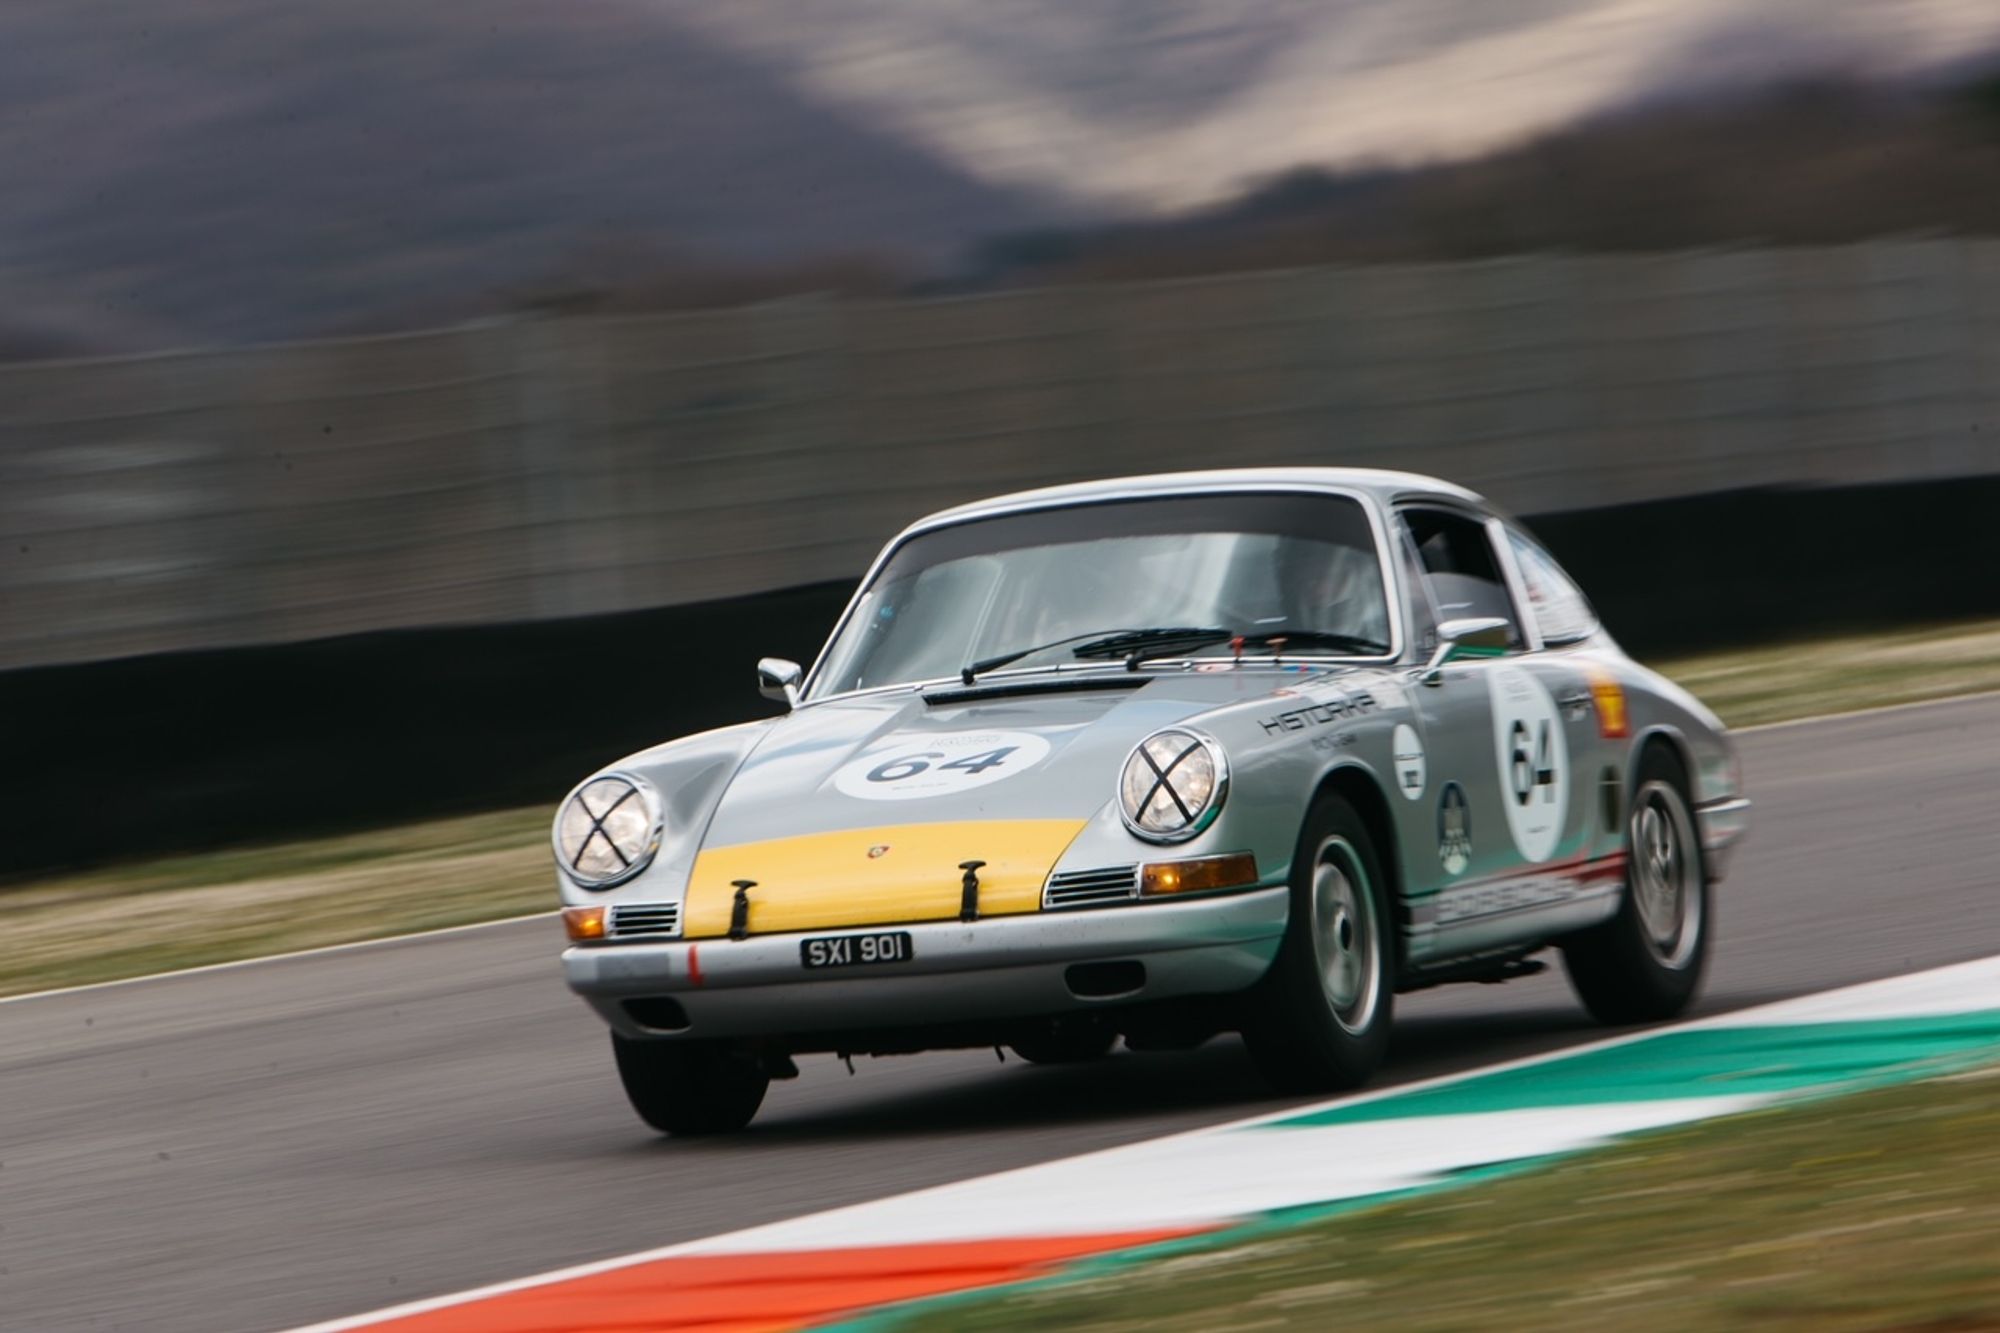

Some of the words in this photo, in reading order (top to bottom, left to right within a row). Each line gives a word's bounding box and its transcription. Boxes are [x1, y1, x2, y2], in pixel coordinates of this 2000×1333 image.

[866, 746, 1021, 782] 64
[1509, 718, 1556, 806] 64
[808, 938, 852, 966] SXI
[860, 934, 903, 961] 901
